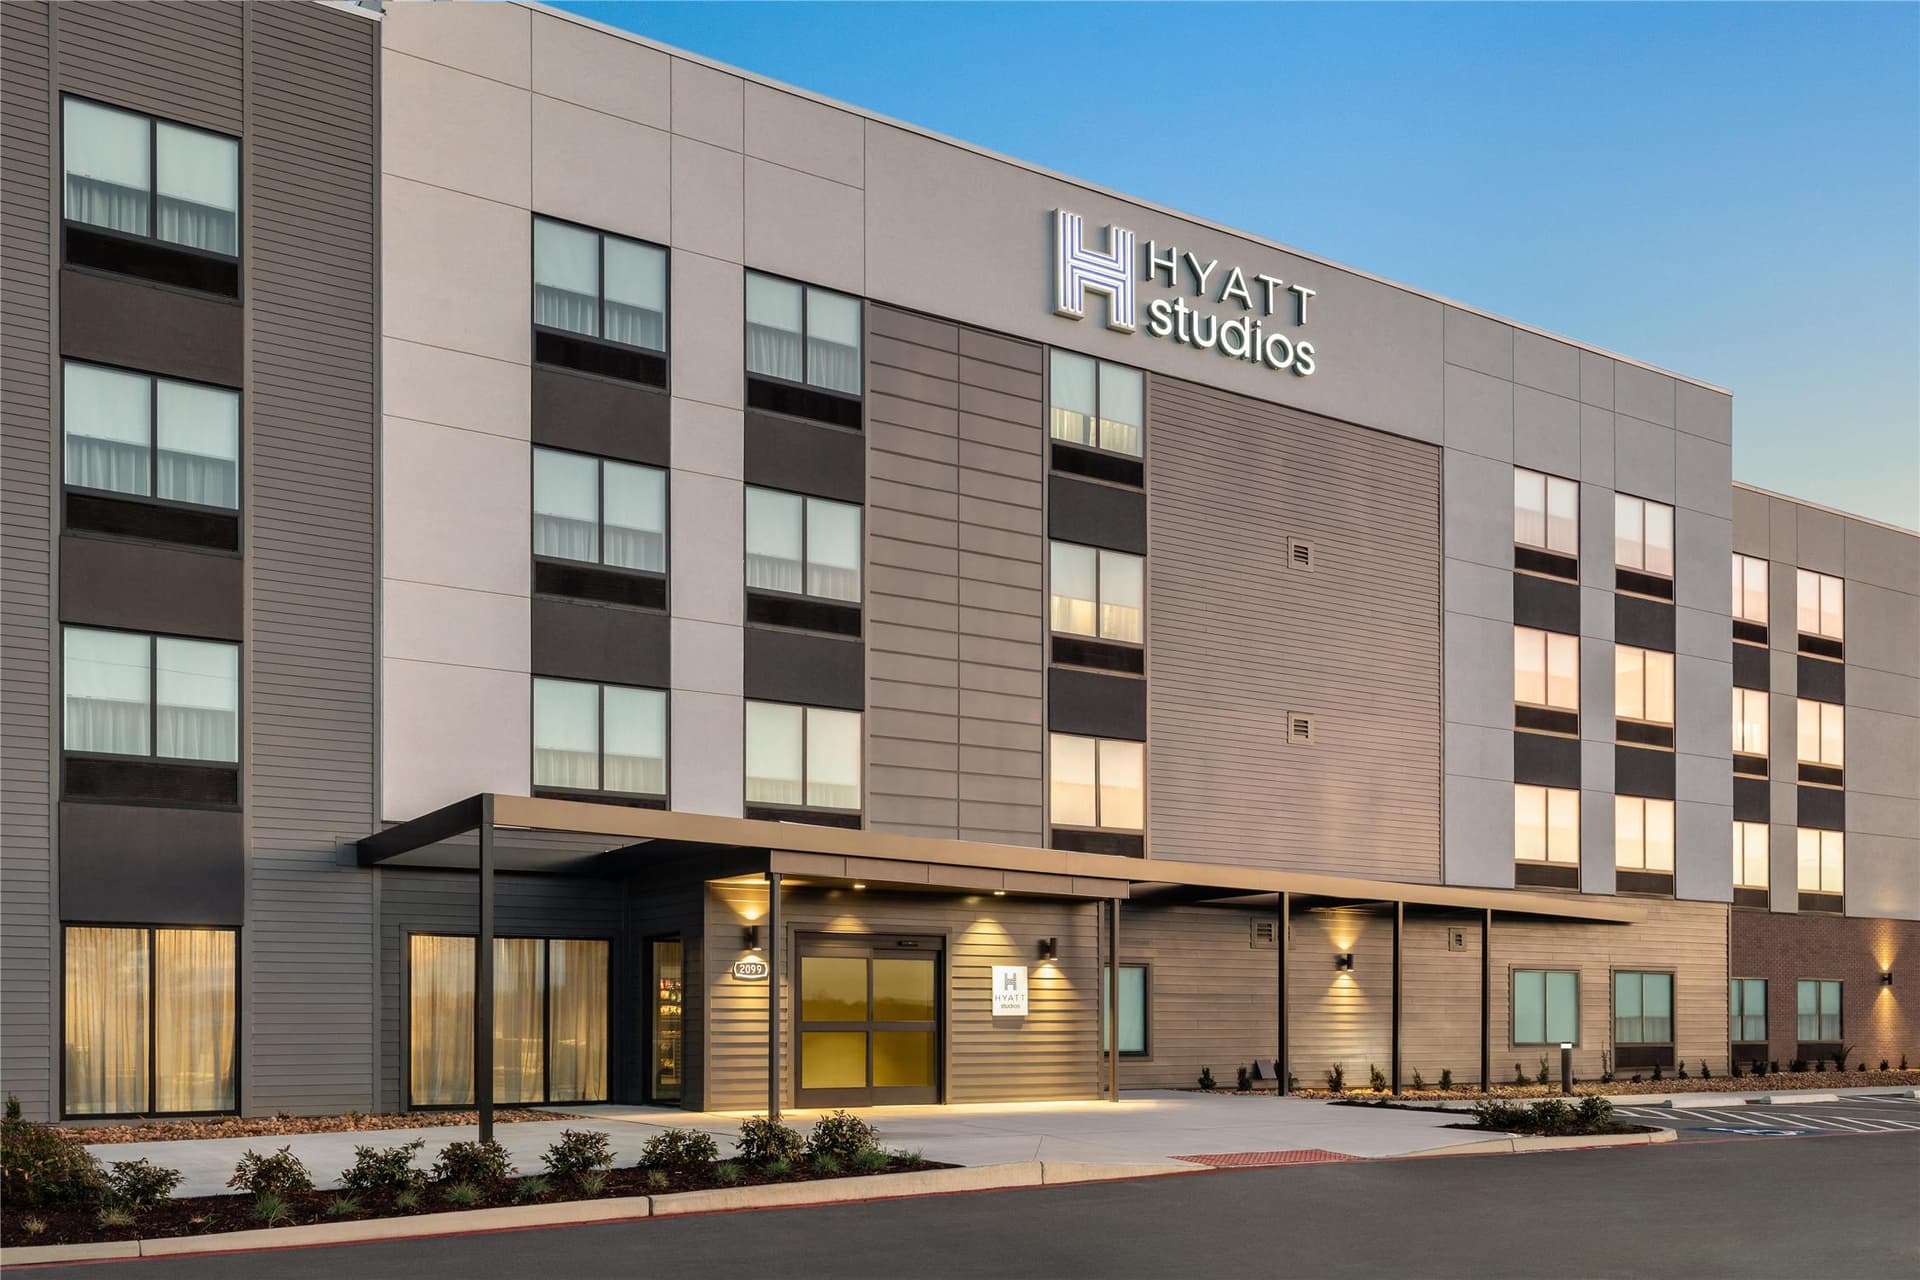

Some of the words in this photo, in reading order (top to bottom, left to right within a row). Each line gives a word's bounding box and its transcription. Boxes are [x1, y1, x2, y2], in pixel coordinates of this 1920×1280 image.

[1146, 239, 1317, 326] HYATT
[1148, 296, 1316, 377] studios
[739, 964, 762, 974] 2099
[994, 994, 1025, 1002] HYATT
